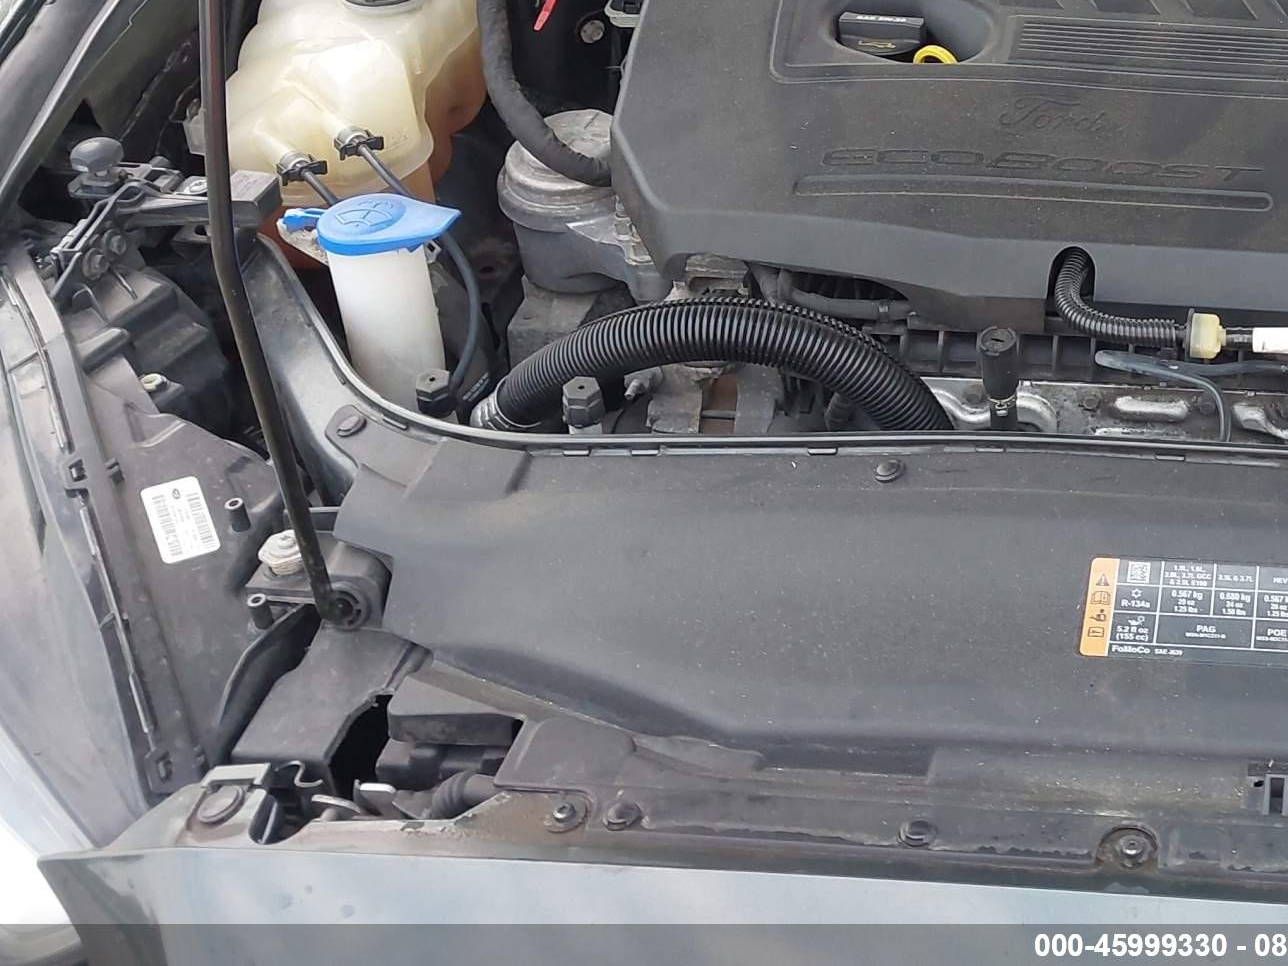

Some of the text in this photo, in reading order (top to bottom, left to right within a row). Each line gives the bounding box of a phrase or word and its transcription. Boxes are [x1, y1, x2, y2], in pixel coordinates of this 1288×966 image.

[999, 94, 1112, 132] Ford
[821, 148, 1265, 181] ECOBOOST
[1196, 624, 1217, 633] PAG
[1267, 628, 1288, 637] POE
